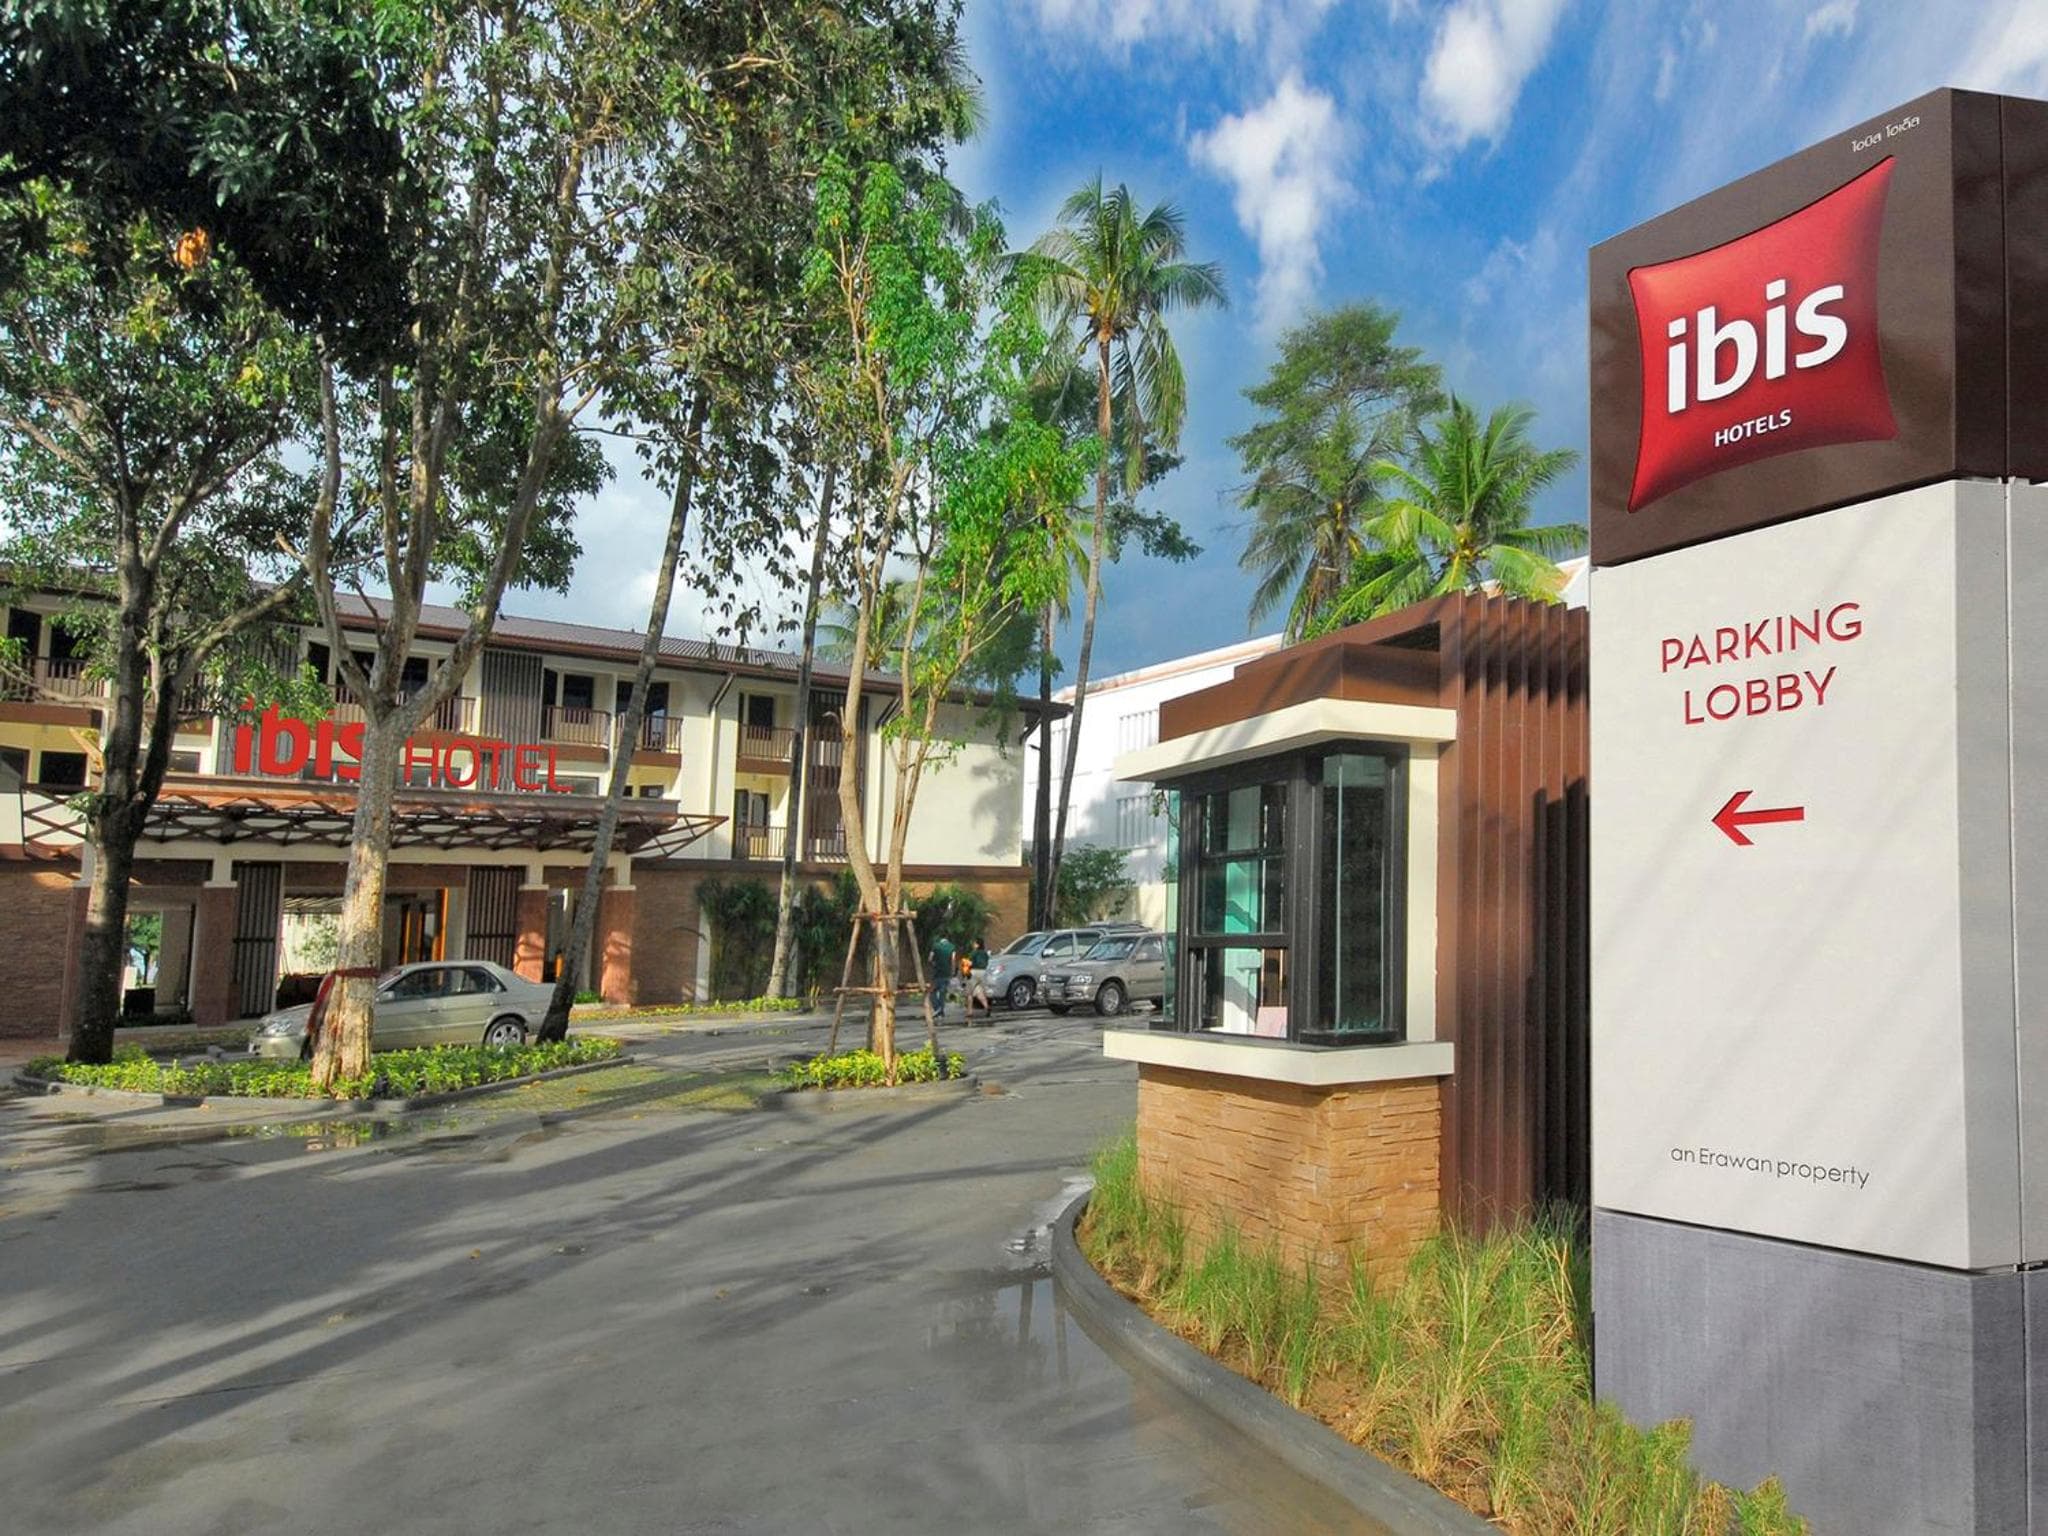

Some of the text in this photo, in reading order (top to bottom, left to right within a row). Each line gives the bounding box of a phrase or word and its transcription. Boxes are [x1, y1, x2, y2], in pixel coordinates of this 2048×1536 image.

[1667, 278, 1849, 414] ibis
[1714, 409, 1792, 448] HOTELS
[1661, 602, 1863, 674] PARKING
[1684, 665, 1838, 726] LOBBY
[403, 737, 574, 794] HOTEL
[1670, 1147, 1871, 1190] an Erawan property
